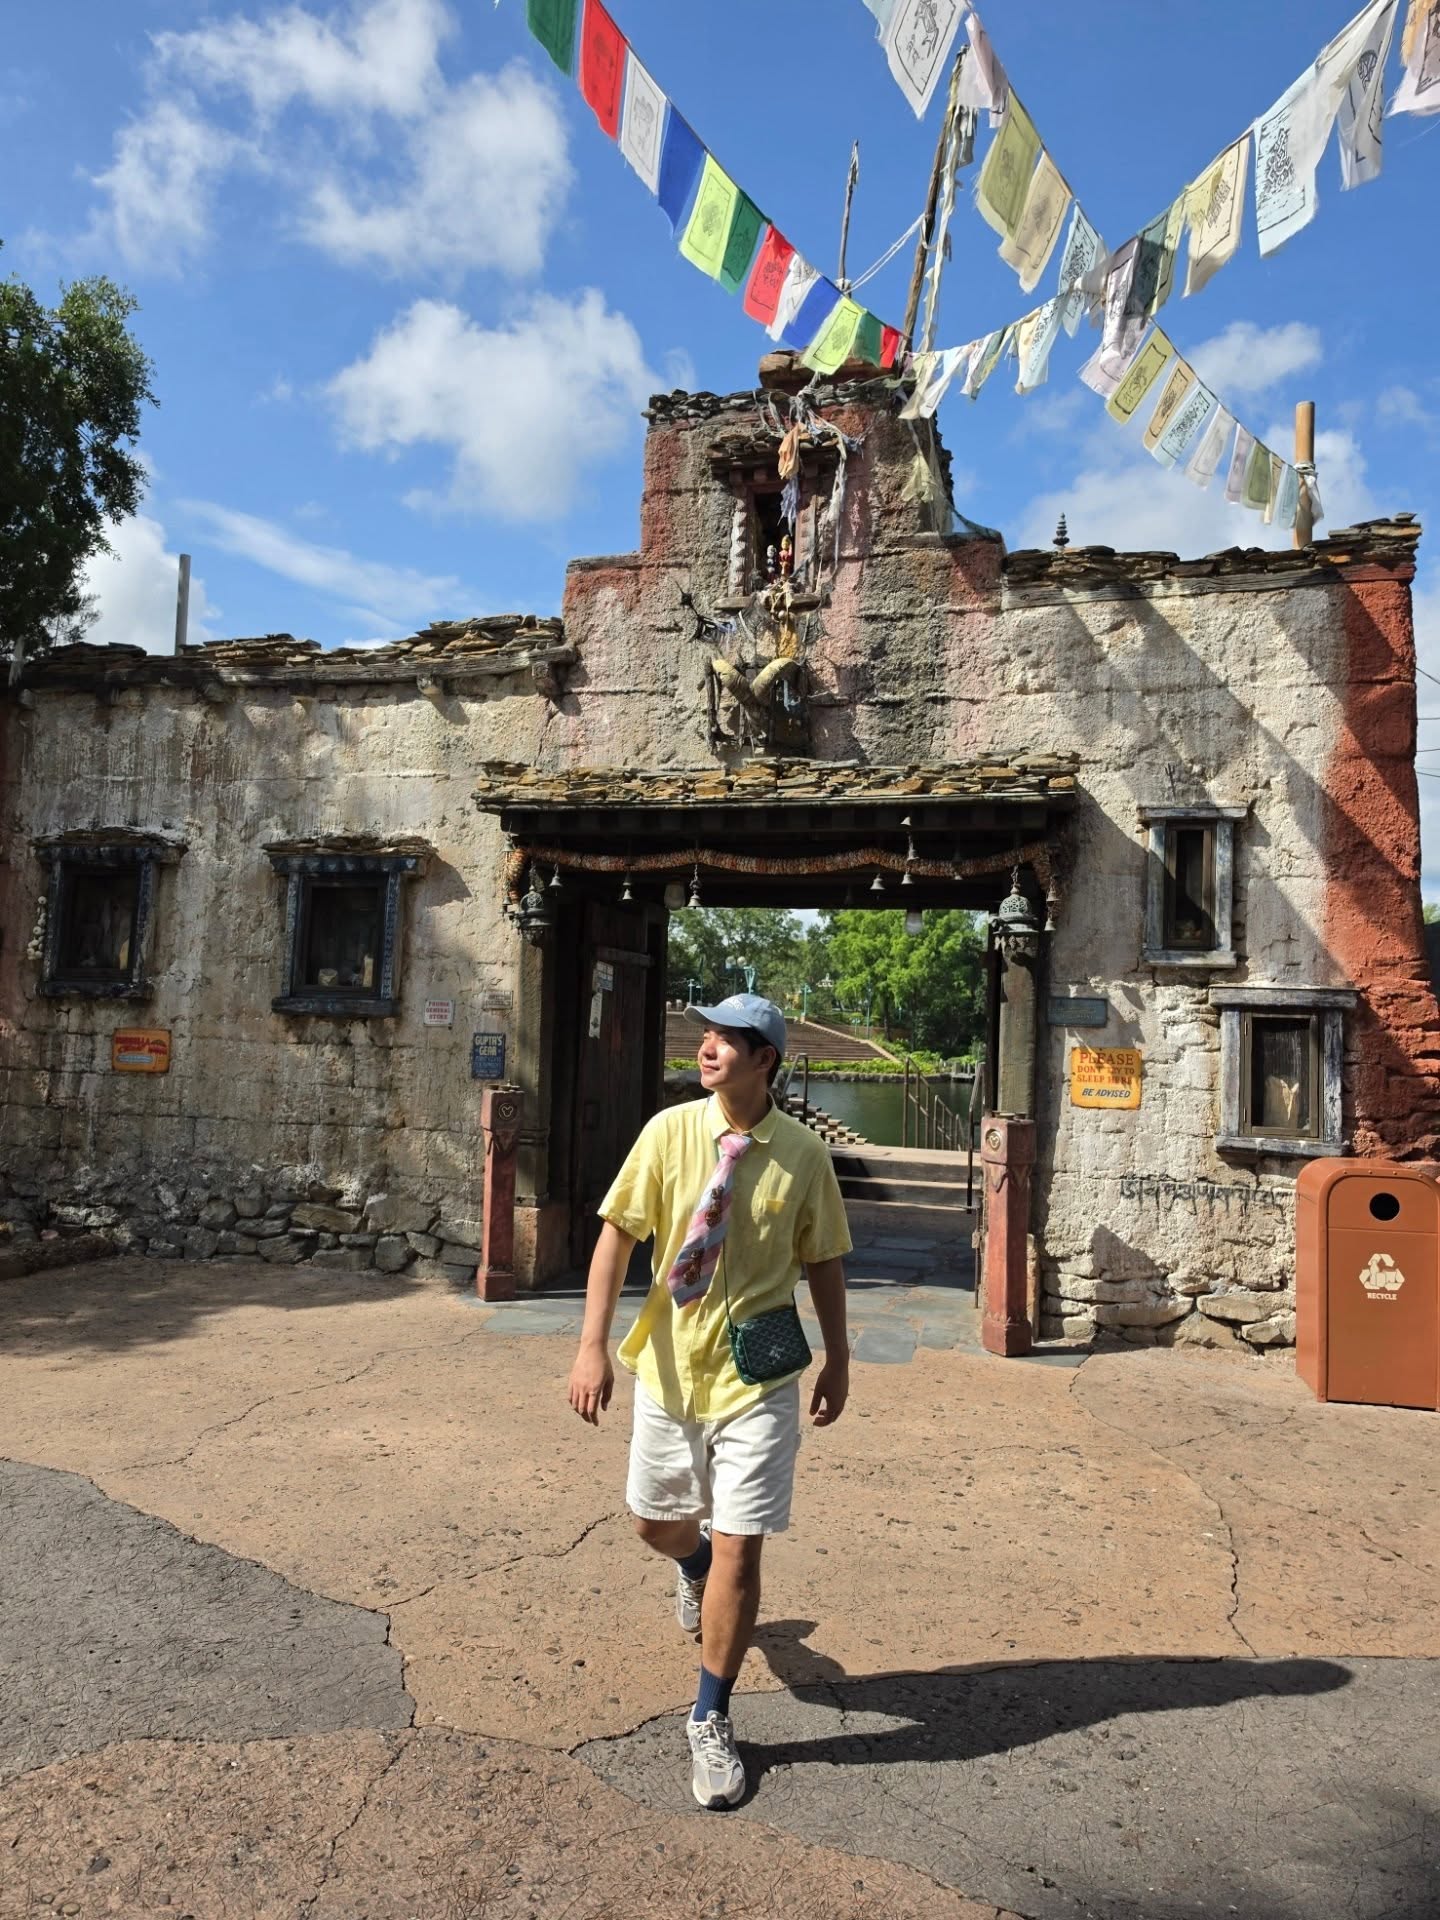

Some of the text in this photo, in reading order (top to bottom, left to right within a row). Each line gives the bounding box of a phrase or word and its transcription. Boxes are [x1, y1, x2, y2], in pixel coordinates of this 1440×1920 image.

[475, 1035, 503, 1046] GUPTA'S
[479, 1046, 497, 1056] GEAR
[1079, 1052, 1134, 1066] PLEASE
[1123, 1067, 1135, 1076] TO
[1077, 1074, 1132, 1085] SLEEP HERE
[1082, 1088, 1131, 1099] BE ADVISED
[1367, 1292, 1397, 1300] RECYCLE
